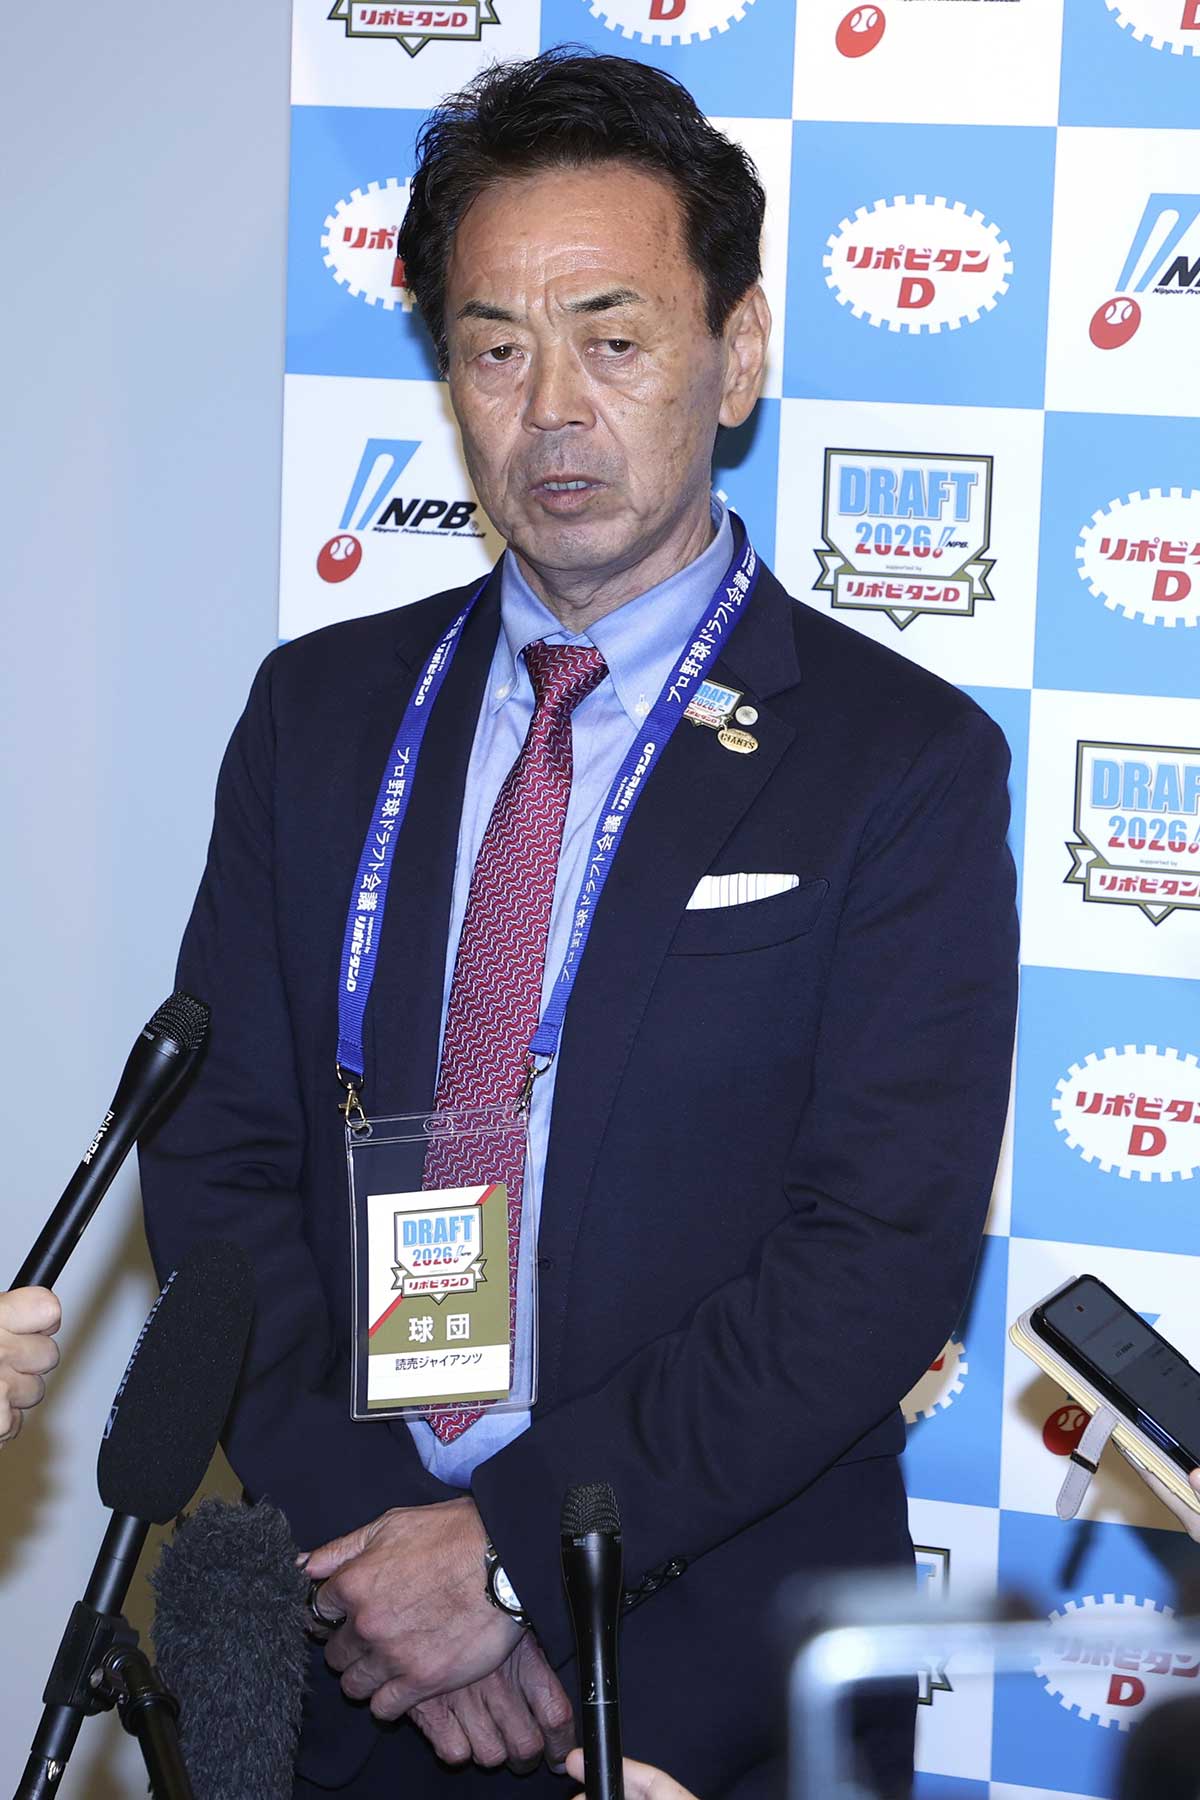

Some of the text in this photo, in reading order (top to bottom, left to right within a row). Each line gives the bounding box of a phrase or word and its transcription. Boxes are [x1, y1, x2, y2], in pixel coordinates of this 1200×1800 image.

[360, 8, 468, 28] リポビタンD
[846, 244, 990, 273] リポビタン
[897, 277, 935, 309] D
[839, 464, 978, 522] DRAFT
[377, 498, 478, 530] NPB
[1099, 536, 1200, 565] リポビ
[846, 581, 961, 602] リポビタンD
[1151, 569, 1192, 602] D
[667, 570, 751, 703] プロ野球ドラフト会議
[1091, 758, 1200, 816] DRAF
[357, 747, 410, 911] プロ野球ドラフト会議
[1099, 874, 1200, 898] リポビタン
[1075, 1091, 1200, 1124] リポビタ
[1128, 1124, 1167, 1157] D
[403, 1215, 475, 1247] DRAFT
[409, 1277, 469, 1291] リポビタンD
[395, 1353, 483, 1371] 読売ジャイアンツ
[1106, 1673, 1146, 1707] D
